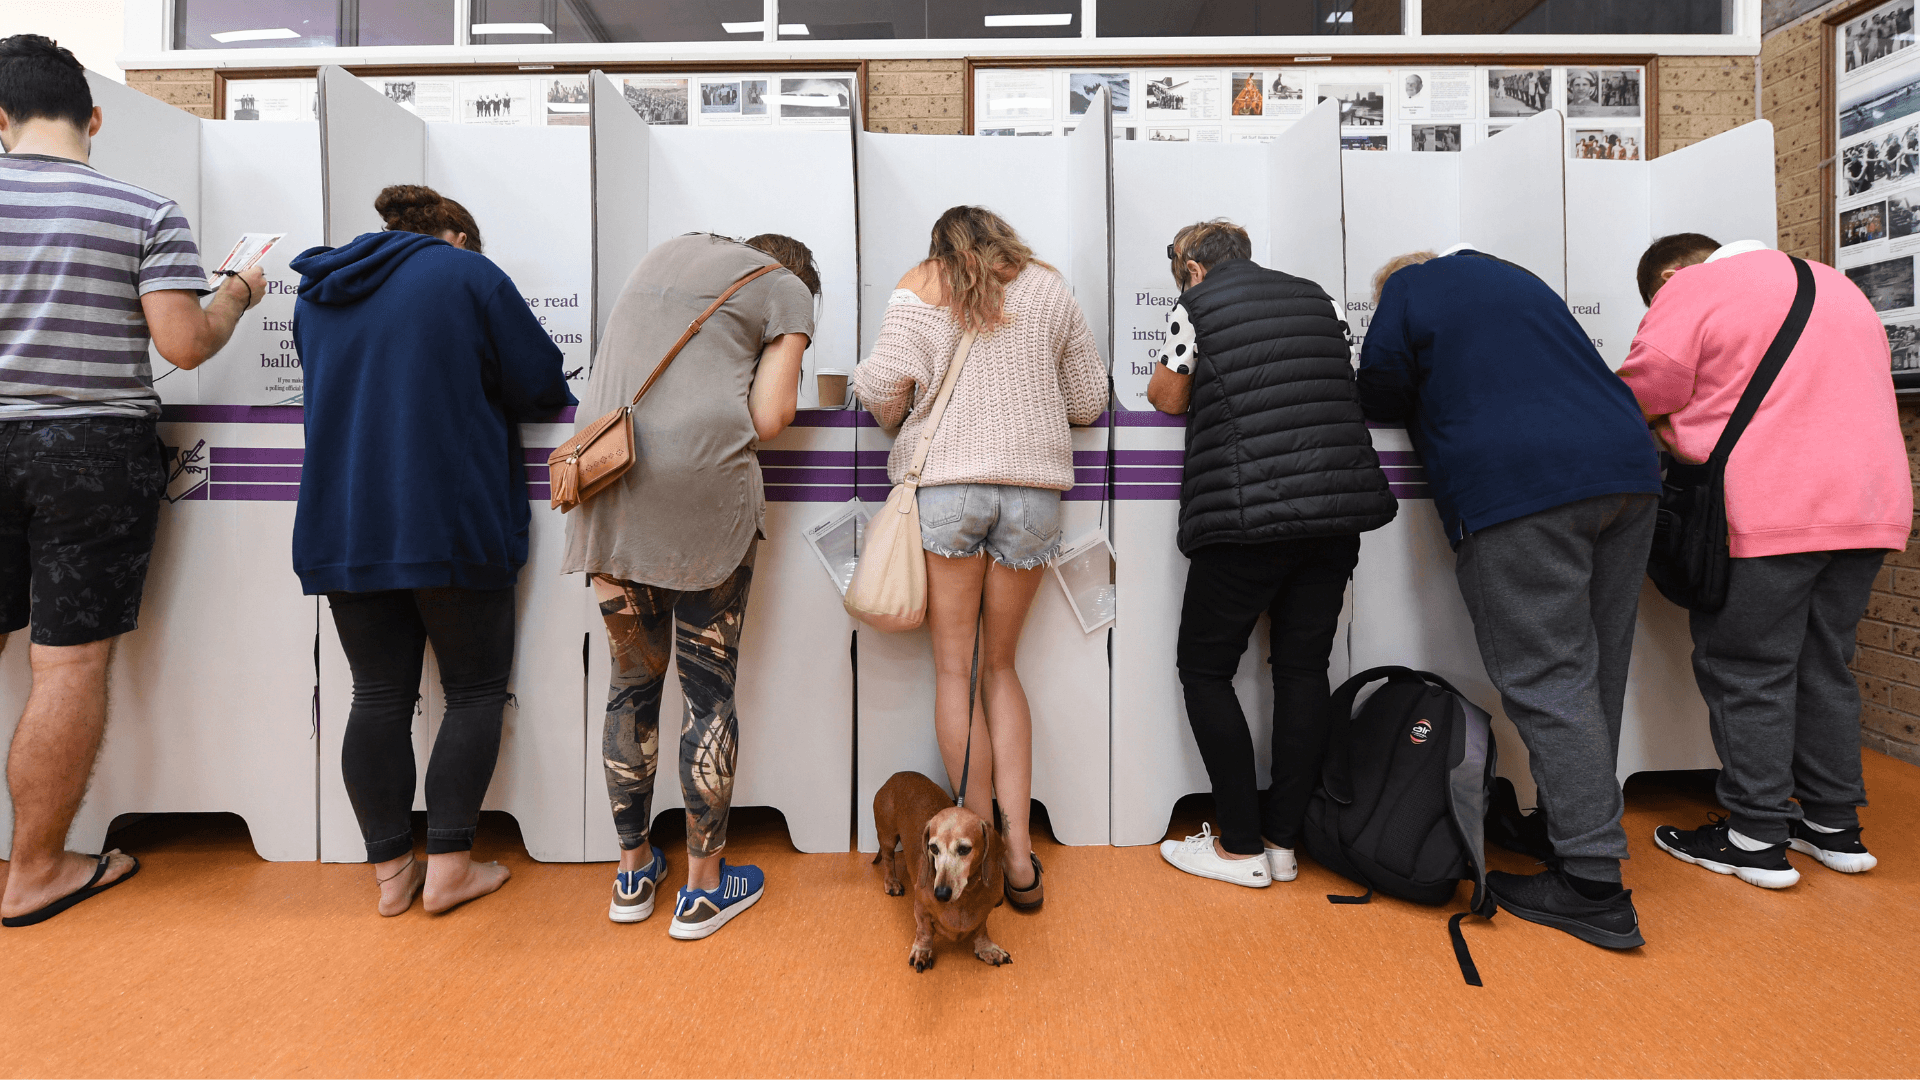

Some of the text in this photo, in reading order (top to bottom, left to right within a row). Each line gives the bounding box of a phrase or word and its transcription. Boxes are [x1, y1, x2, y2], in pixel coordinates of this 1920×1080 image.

[543, 293, 579, 308] read
[1572, 302, 1601, 315] read
[269, 384, 285, 392] polling
